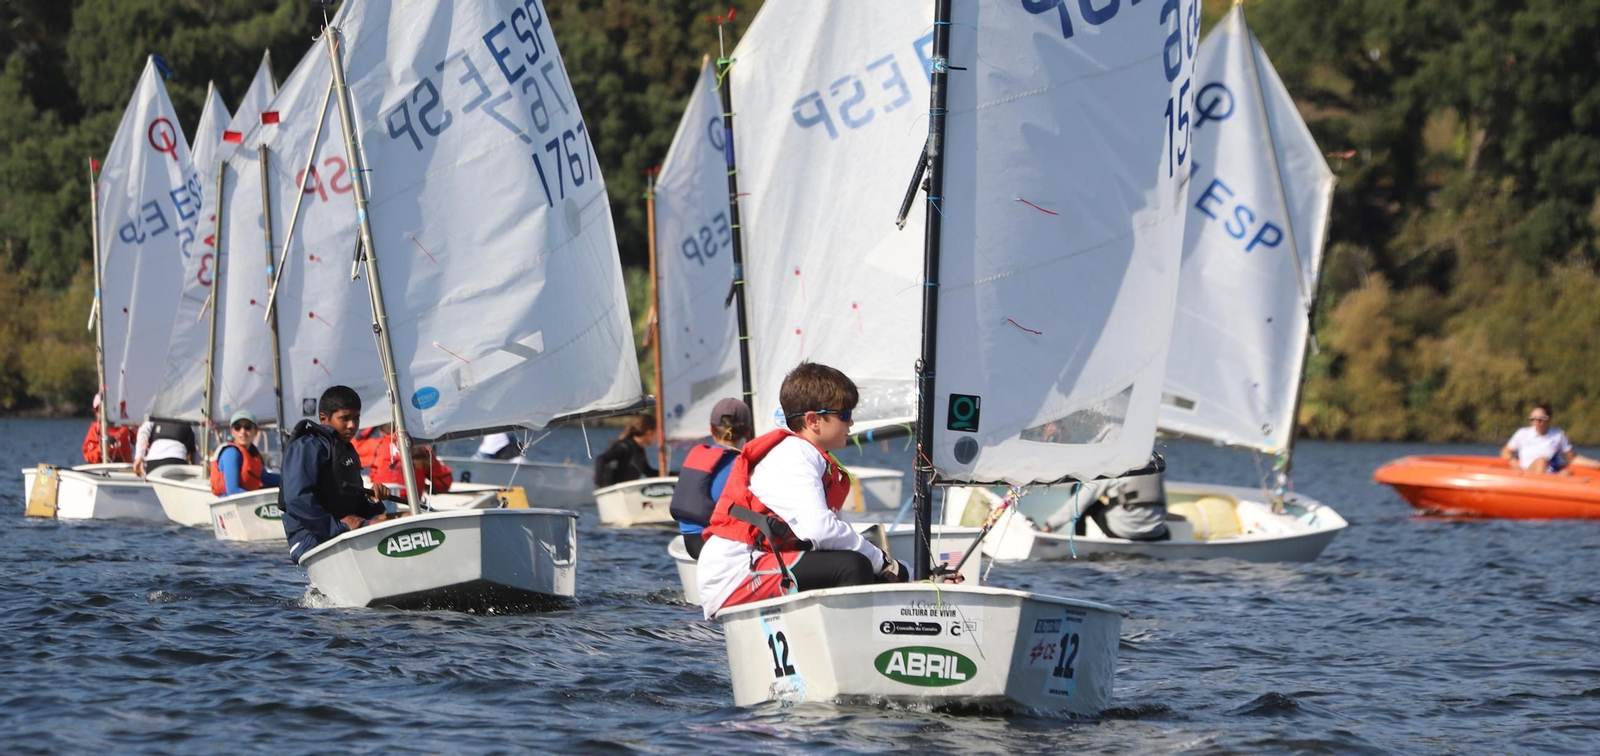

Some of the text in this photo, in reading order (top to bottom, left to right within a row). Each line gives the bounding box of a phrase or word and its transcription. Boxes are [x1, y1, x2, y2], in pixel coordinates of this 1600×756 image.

[483, 0, 546, 85] ESP
[1164, 78, 1192, 178] 15
[531, 120, 593, 208] 1767
[1195, 178, 1284, 253] ESP
[386, 529, 440, 556] ABRIL
[900, 607, 957, 618] CULTURA DE VIVIR
[768, 631, 796, 678] 12
[885, 650, 966, 681] ABRIL
[1053, 632, 1080, 679] 12
